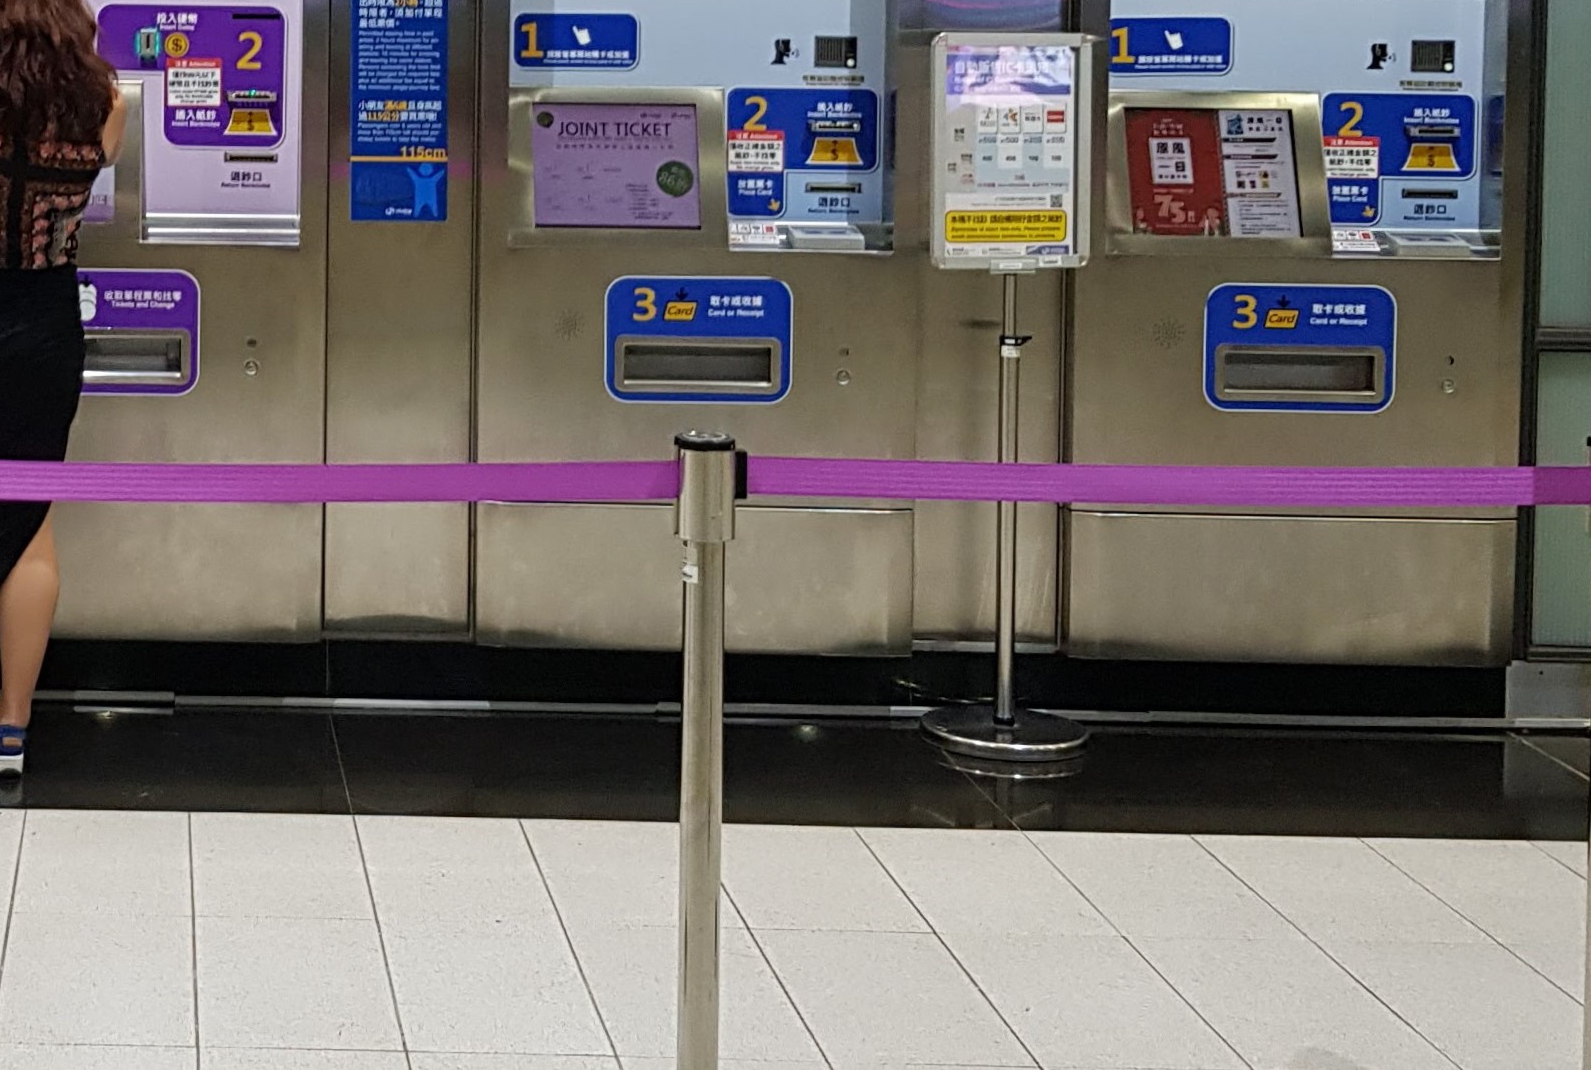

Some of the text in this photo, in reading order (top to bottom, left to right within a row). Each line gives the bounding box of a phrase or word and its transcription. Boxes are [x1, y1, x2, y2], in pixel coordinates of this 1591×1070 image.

[237, 32, 262, 69] 2
[521, 22, 543, 57] 1
[1112, 27, 1135, 63] 1
[558, 122, 671, 136] JOINT TICKET
[744, 97, 767, 130] 2
[1339, 102, 1363, 137] 2
[399, 146, 447, 157] 115cm
[633, 288, 656, 321] 3
[667, 305, 694, 316] Card
[1233, 295, 1257, 328] 3
[1268, 313, 1296, 325] Card
